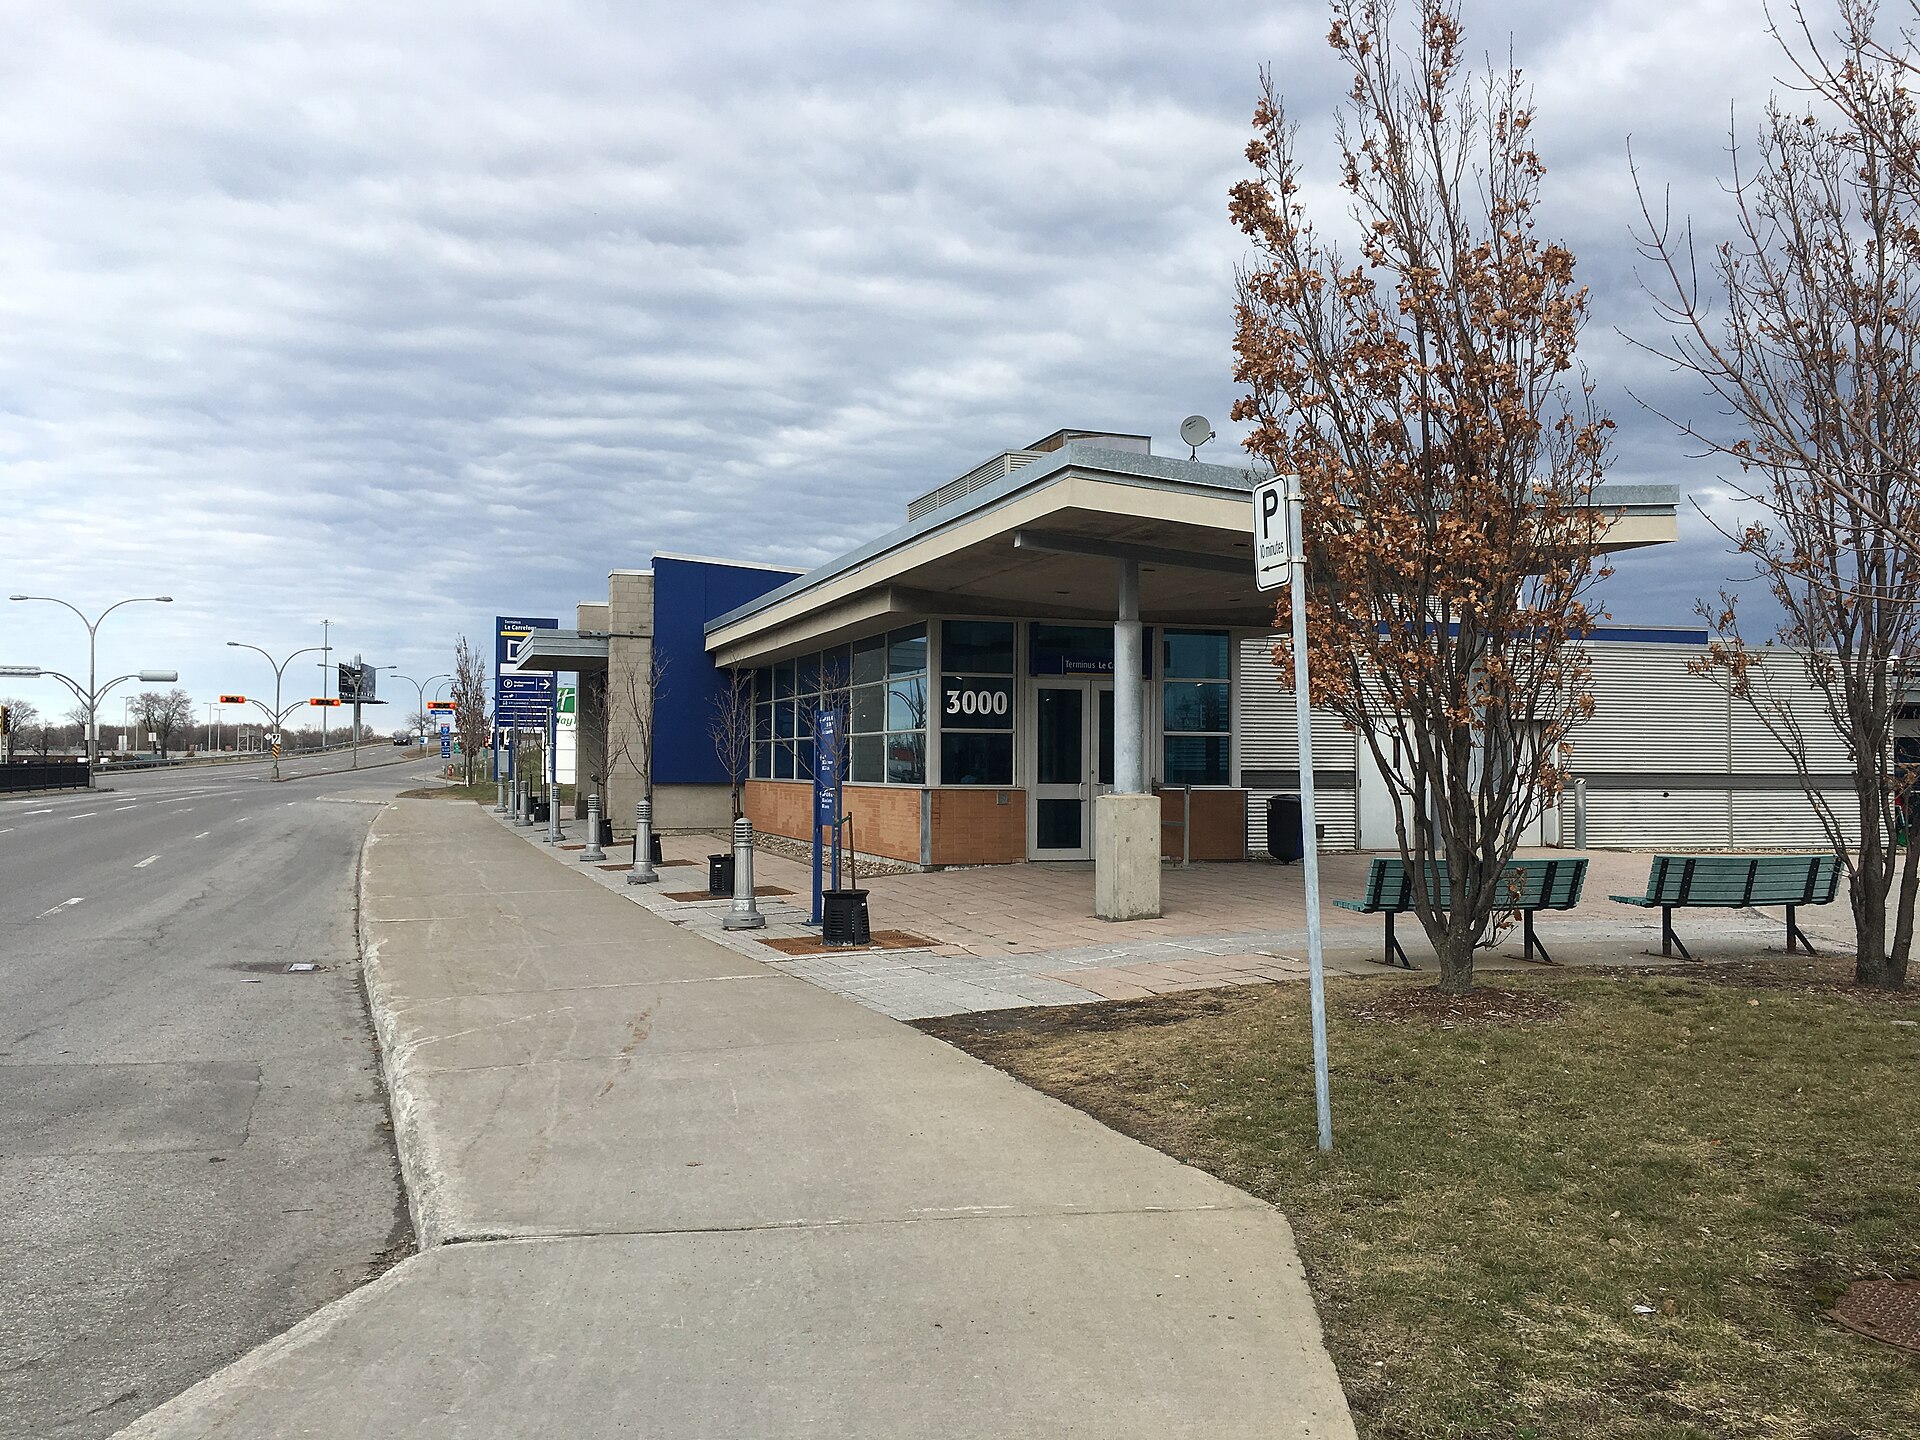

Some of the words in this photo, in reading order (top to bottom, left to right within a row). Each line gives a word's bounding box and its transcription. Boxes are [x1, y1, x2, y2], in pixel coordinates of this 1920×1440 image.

[1262, 489, 1278, 539] P
[1266, 541, 1284, 557] minutes
[1065, 659, 1096, 669] Terminus
[1098, 661, 1107, 669] Le
[1107, 661, 1114, 670] C
[946, 690, 1008, 715] 3000
